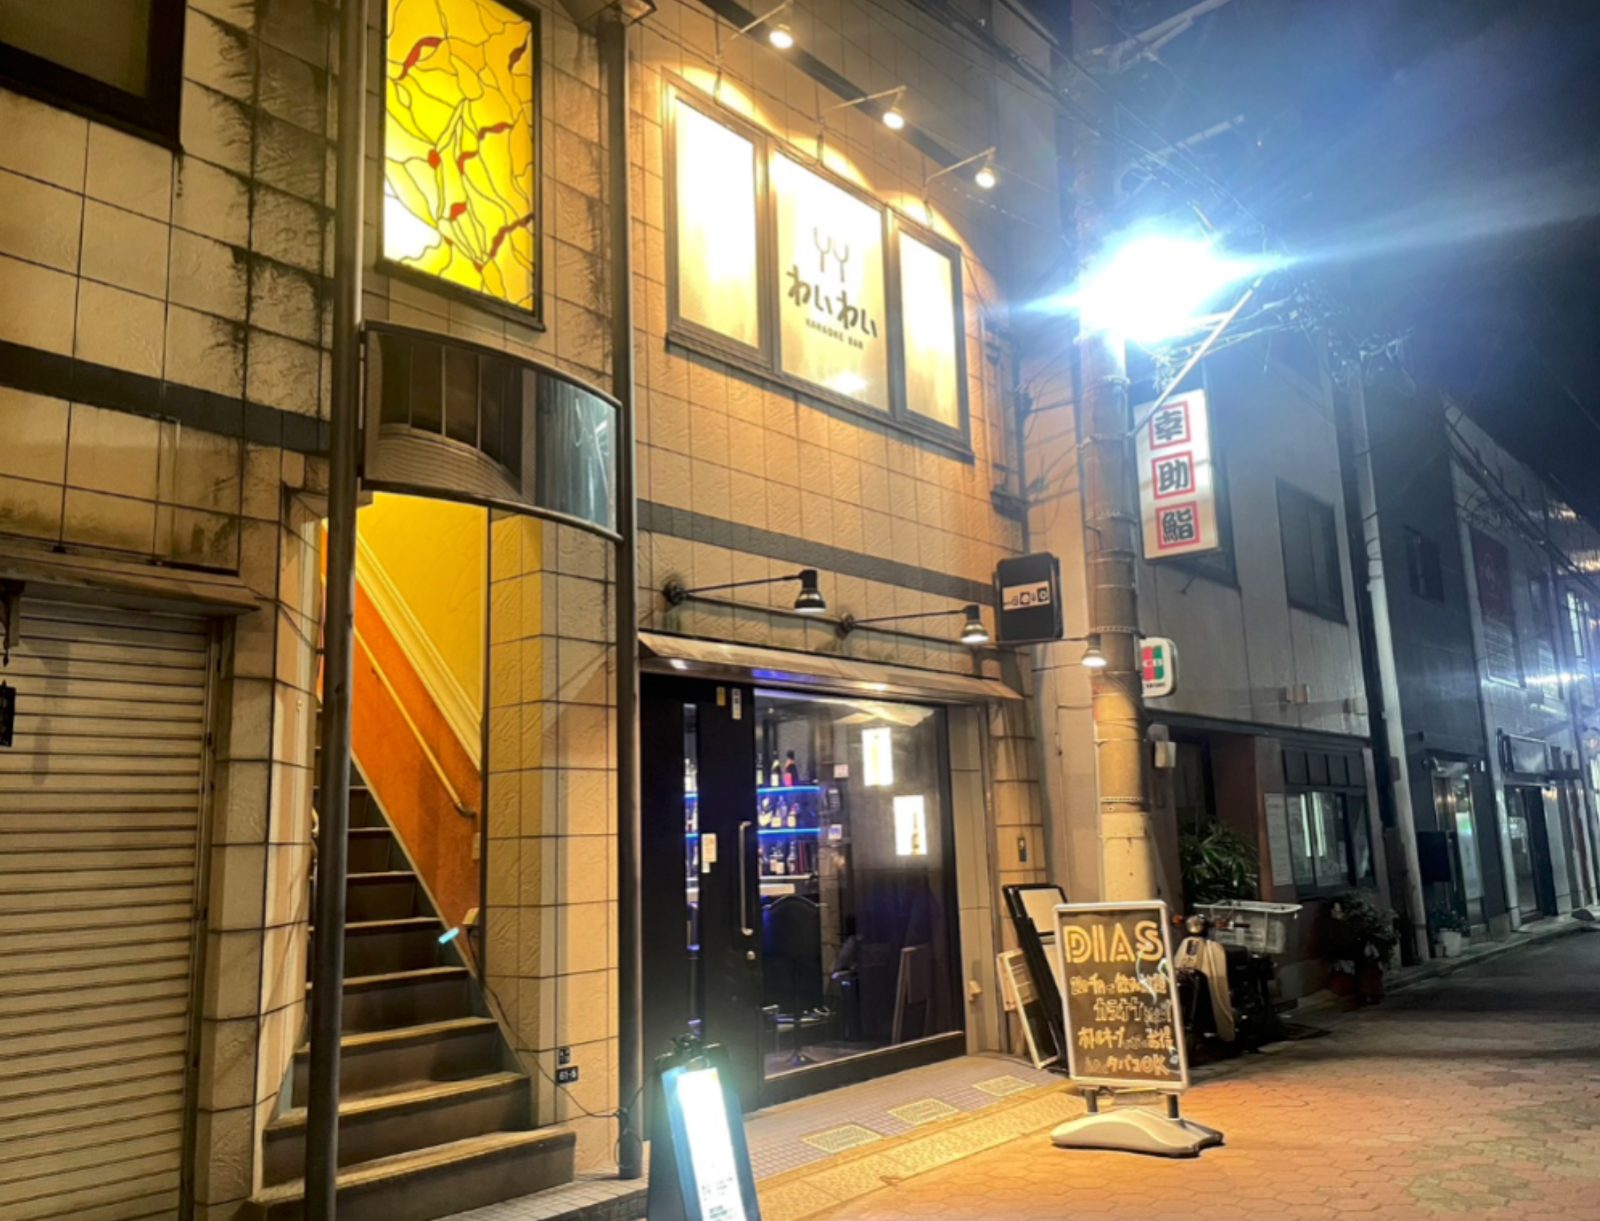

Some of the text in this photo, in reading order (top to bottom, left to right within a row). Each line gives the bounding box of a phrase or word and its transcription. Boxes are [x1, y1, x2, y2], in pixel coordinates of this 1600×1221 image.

[786, 264, 878, 338] わいわい
[1154, 410, 1194, 544] 幸助鮨
[1062, 920, 1165, 963] DIAS
